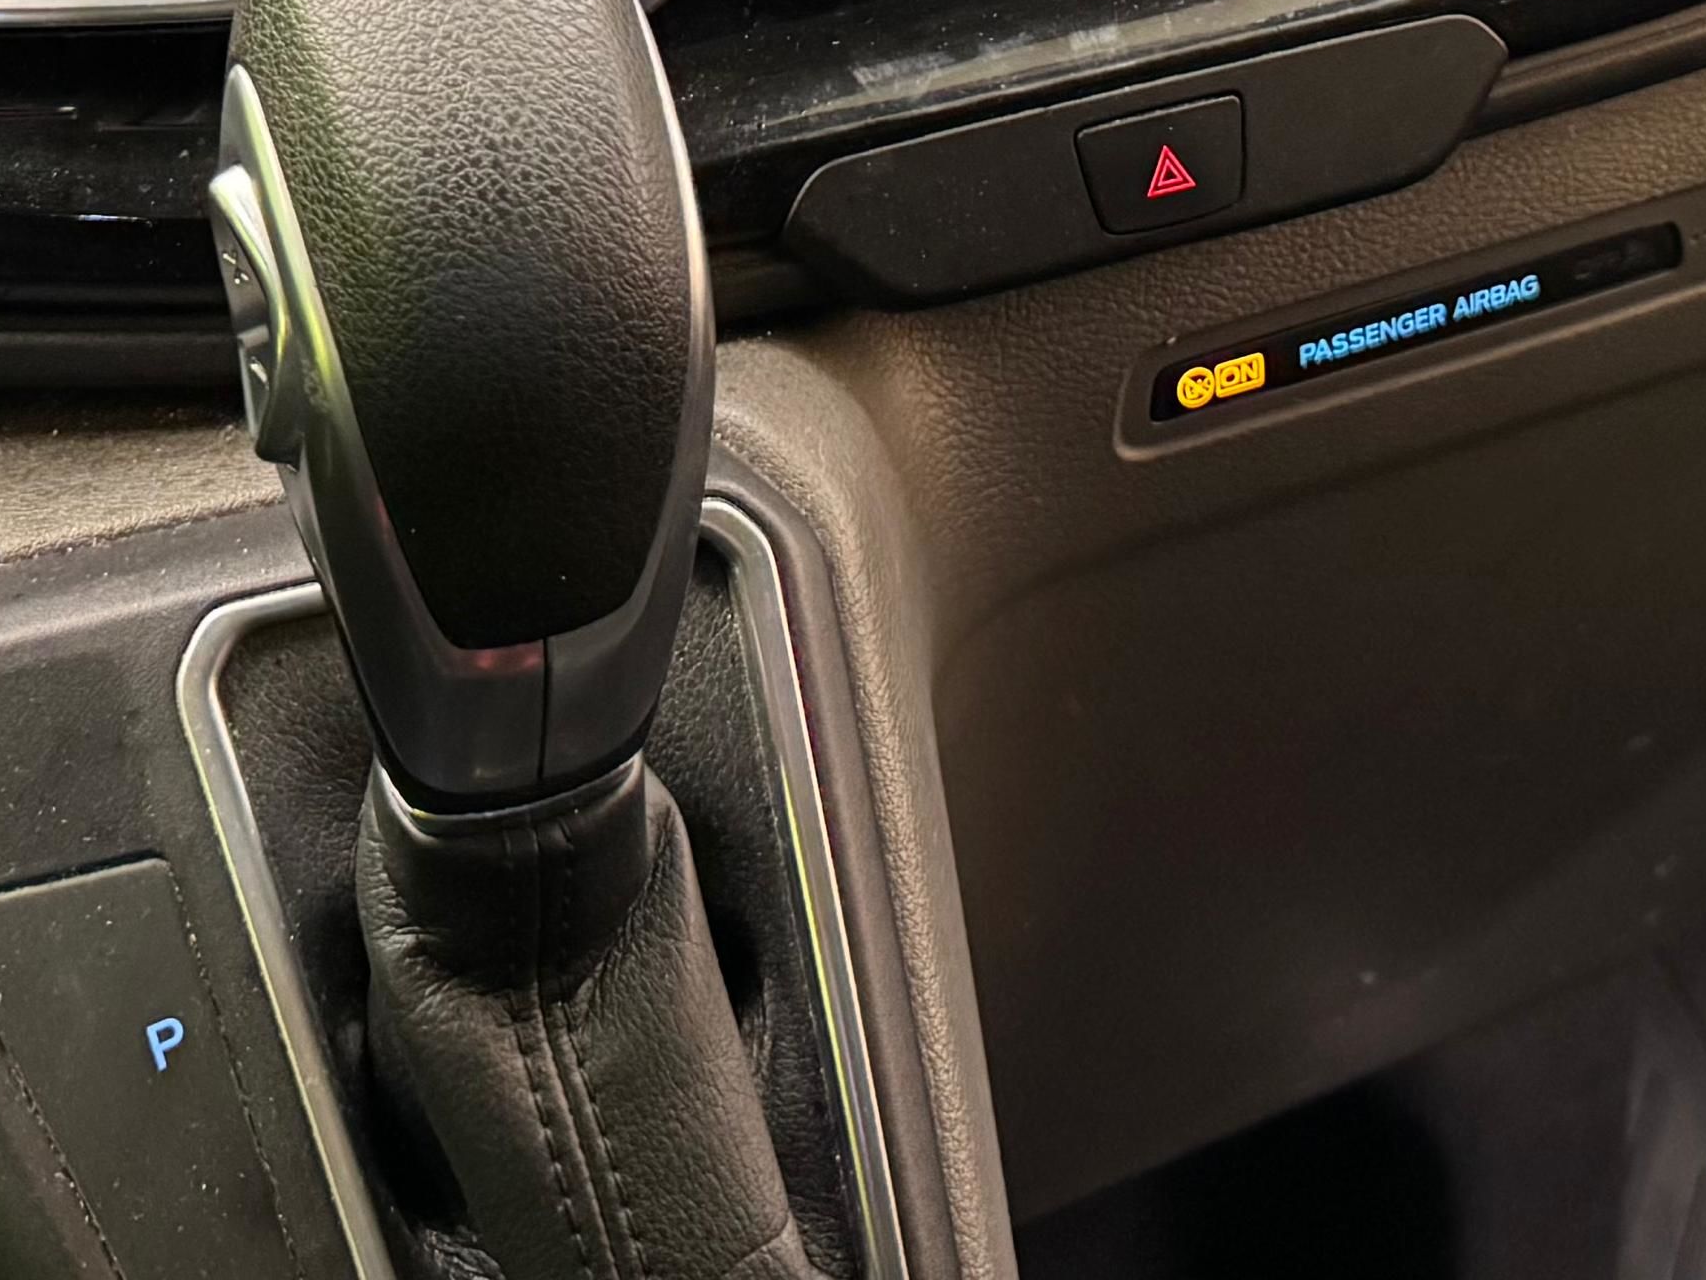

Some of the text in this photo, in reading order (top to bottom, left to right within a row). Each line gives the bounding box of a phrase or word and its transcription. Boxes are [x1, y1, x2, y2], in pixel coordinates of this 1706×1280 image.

[1298, 274, 1541, 369] PASSENGER AIRBAG
[1220, 359, 1259, 389] ON
[146, 1017, 184, 1071] P
